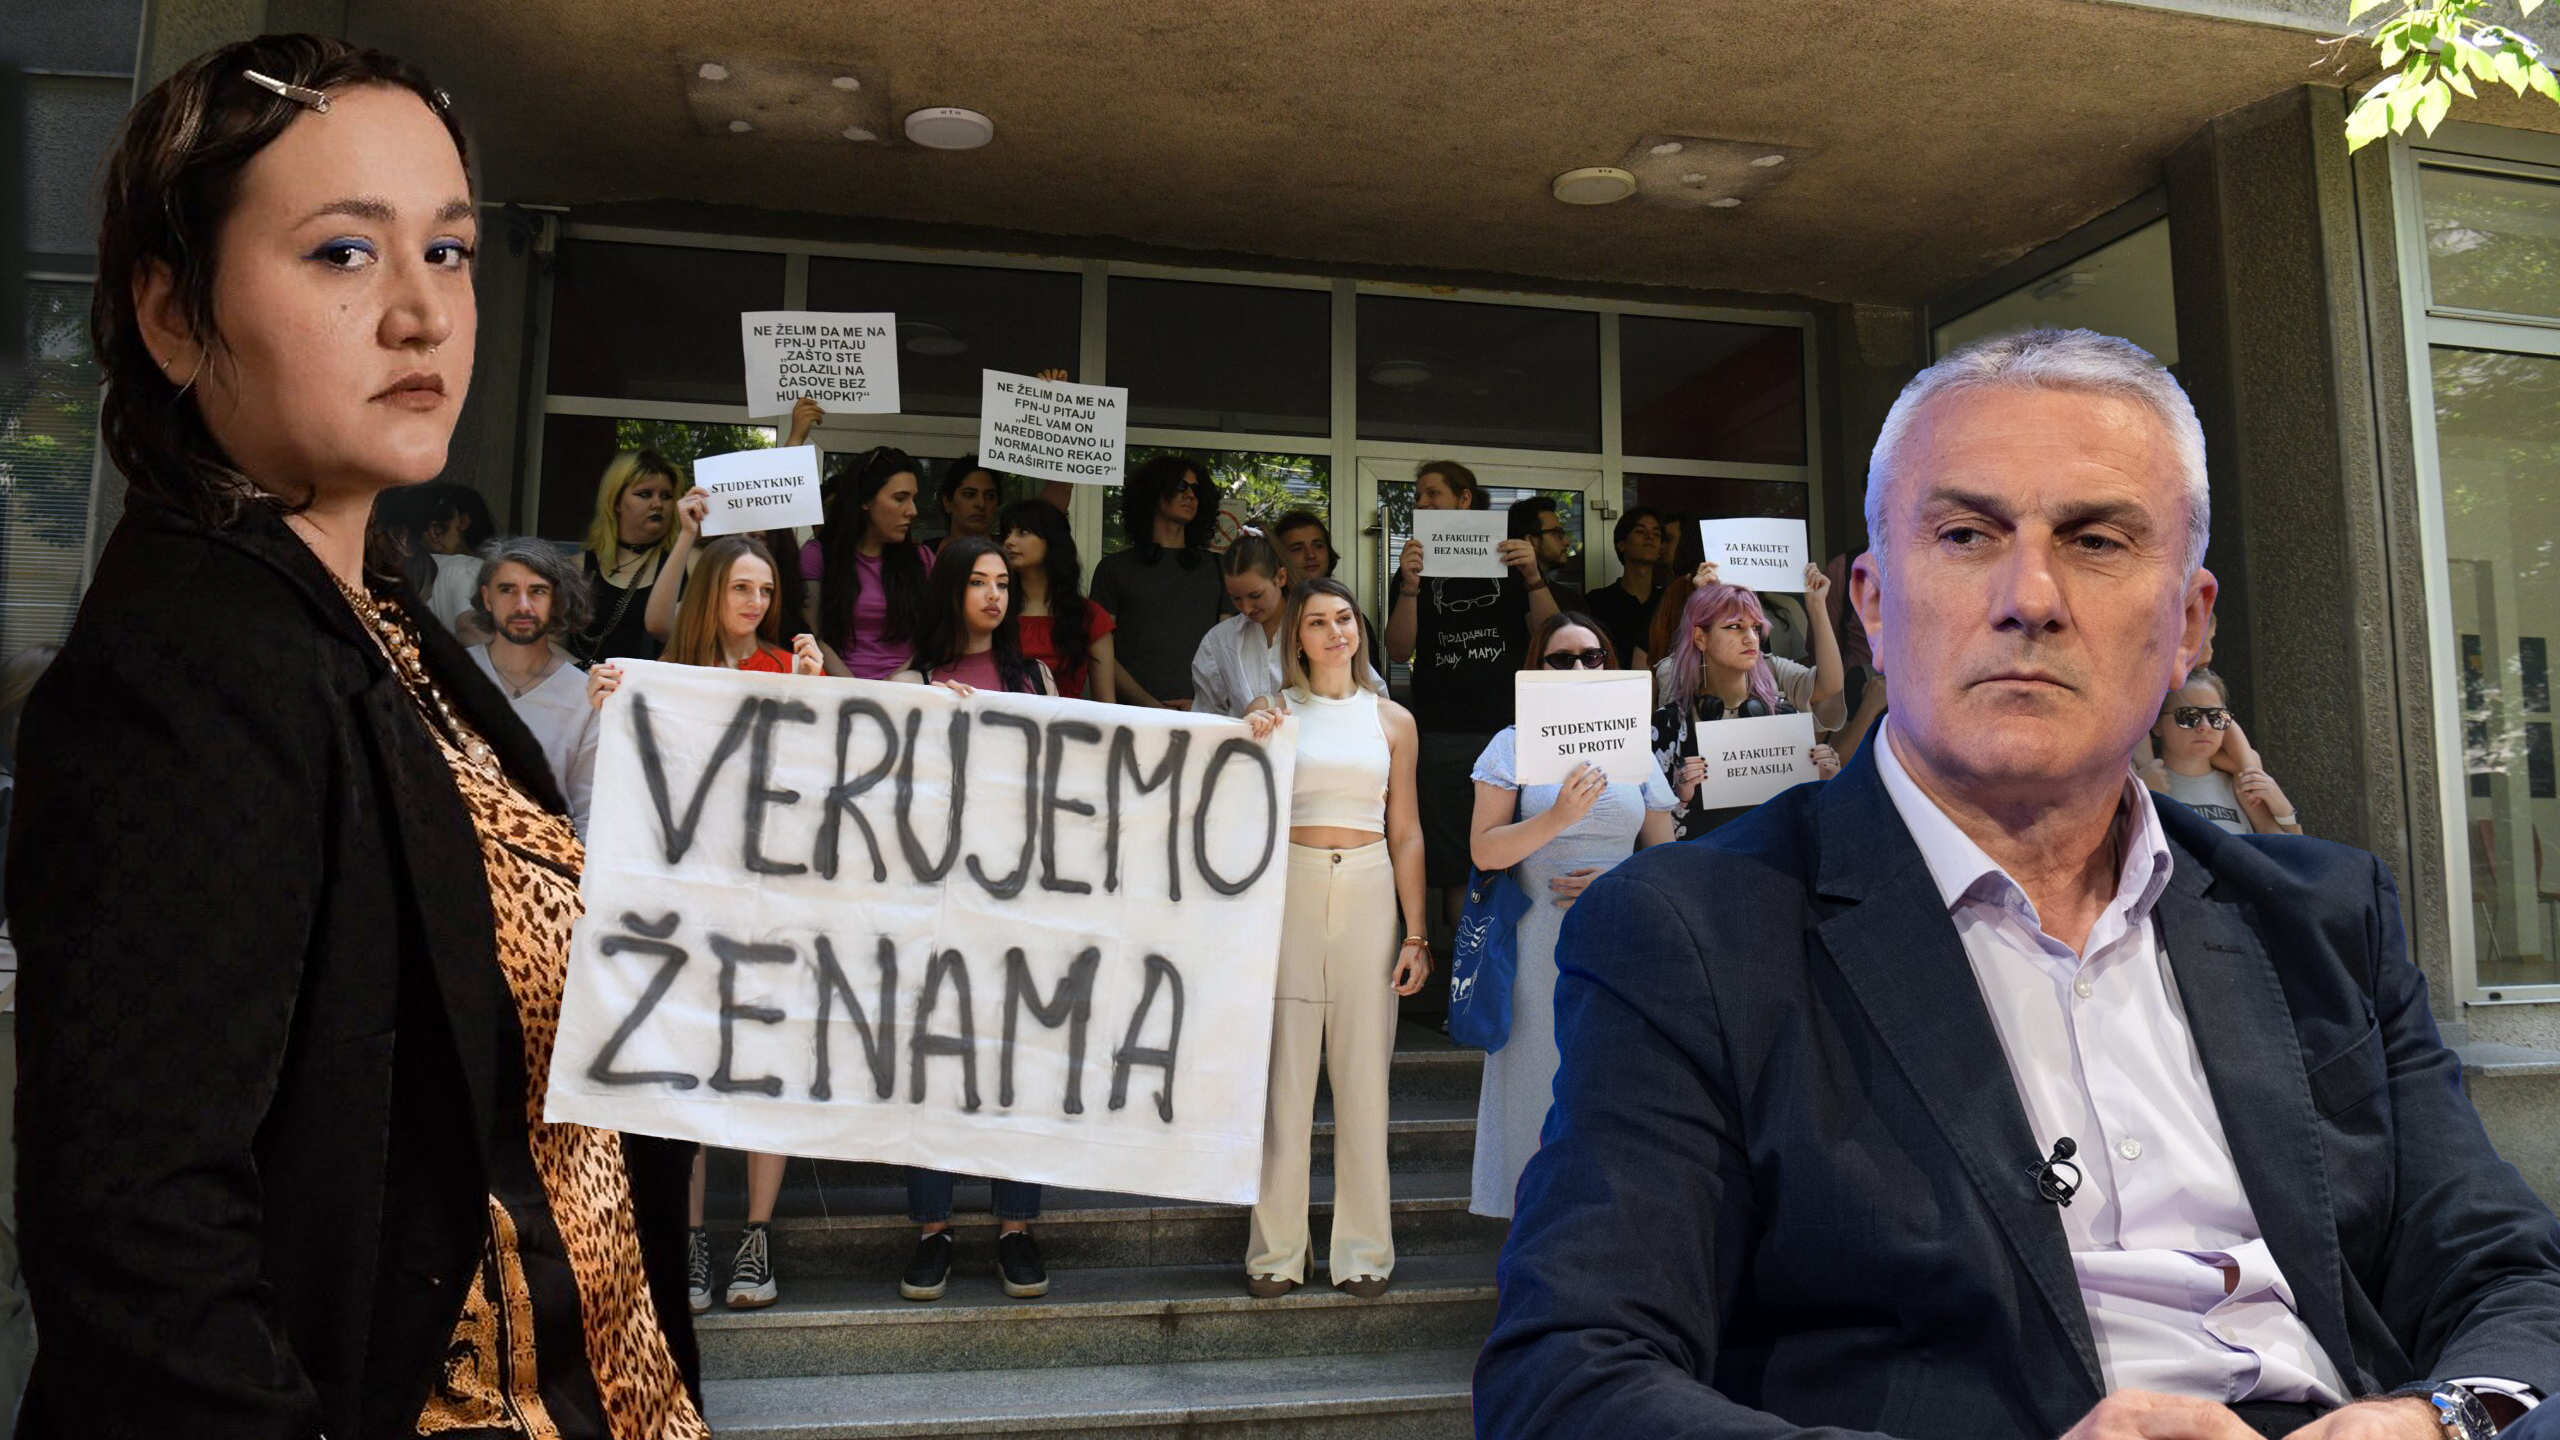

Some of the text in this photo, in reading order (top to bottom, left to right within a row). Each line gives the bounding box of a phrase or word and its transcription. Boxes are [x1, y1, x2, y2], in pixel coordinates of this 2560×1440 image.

[754, 323, 886, 337] NE ŽELIM DA ME NA
[775, 338, 866, 350] FPN-U PITAJU
[836, 352, 862, 362] STE
[780, 364, 864, 375] DOLAZILI NA
[779, 375, 866, 388] ČASOVE BEZ
[997, 382, 1115, 408] NE ŽELIM DA ME NA
[1015, 398, 1096, 420] FPN-U PITAJU
[1046, 418, 1071, 431] VAM
[1074, 423, 1093, 433] ON
[994, 422, 1114, 448] NAREDBODAVNO ILI
[994, 436, 1112, 462] NORMALNO REKAO
[988, 449, 1005, 461] DA
[1008, 453, 1063, 472] RAŠIRITE
[711, 475, 805, 494] STUDENTKINJE
[727, 493, 793, 509] SU PROTIV
[1431, 533, 1491, 543] ZA FAKULTET
[1434, 546, 1488, 557] BEZ NASILJA
[1725, 543, 1790, 553] ZA FAKULTET
[1729, 557, 1789, 568] BEZ NASILJA
[1541, 717, 1638, 738] STUDENTKINJE
[1558, 738, 1626, 755] SU PROTIV
[1722, 745, 1796, 762] ZA FAKULTET
[1727, 762, 1794, 778] BEZ NASILJA
[630, 692, 1277, 900] VERUJEMO
[587, 912, 1185, 1123] ŽENAMA
